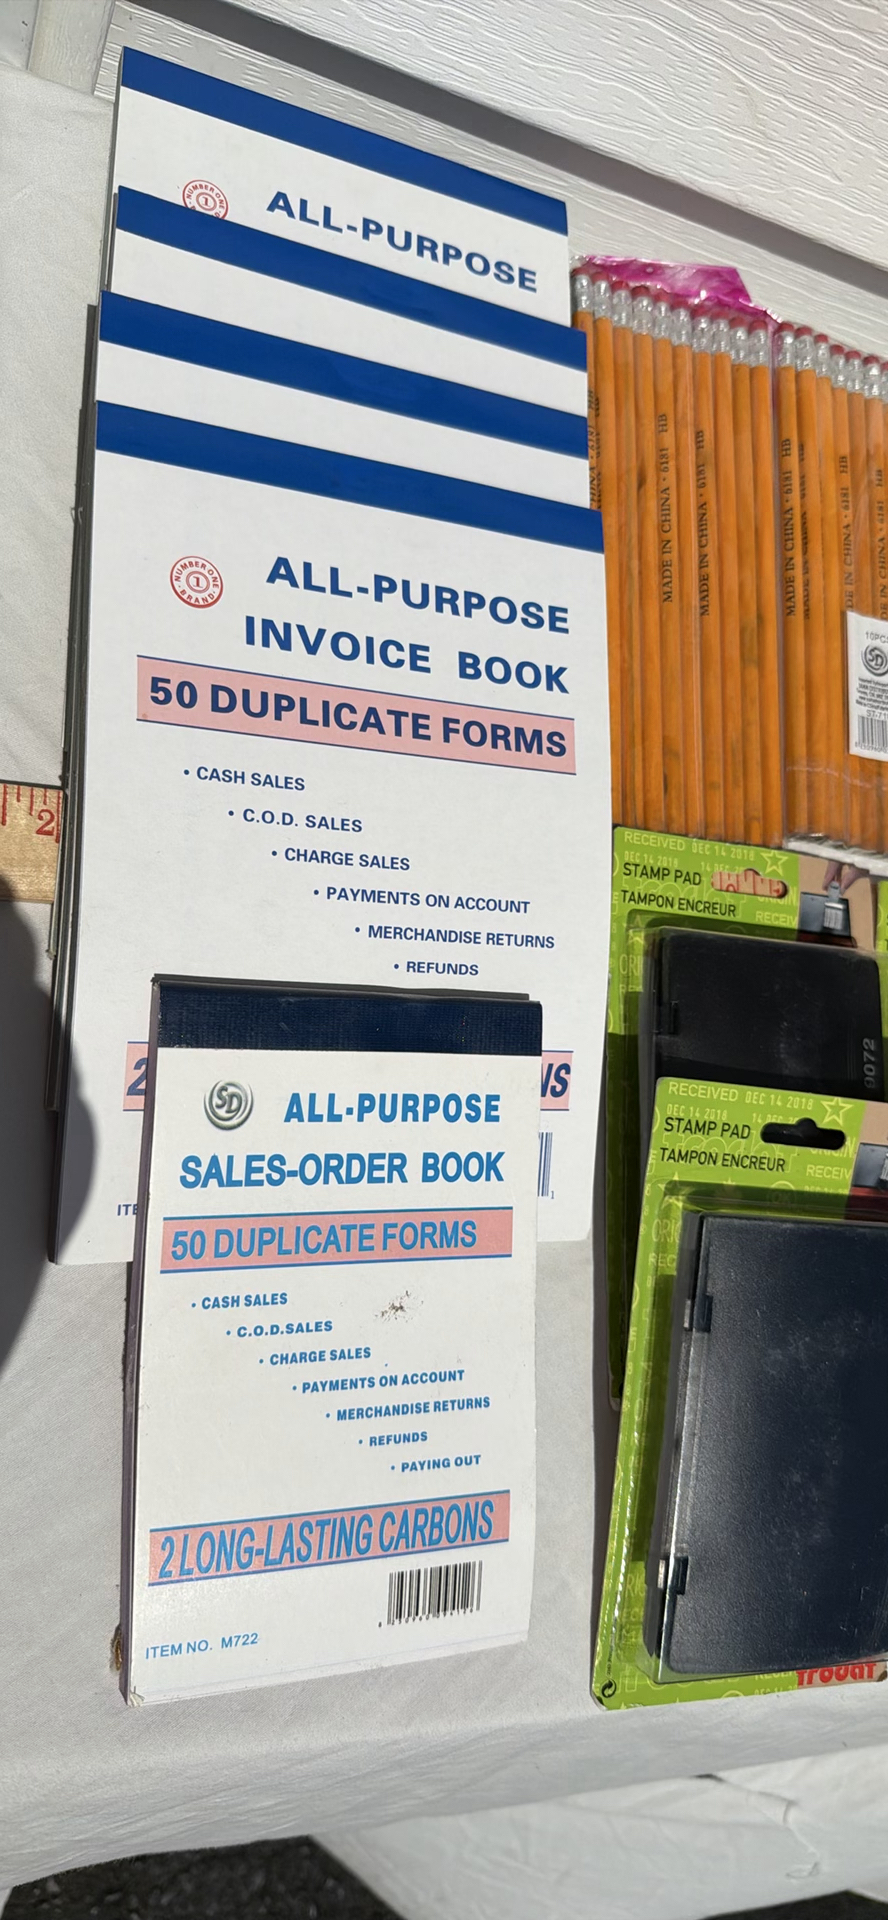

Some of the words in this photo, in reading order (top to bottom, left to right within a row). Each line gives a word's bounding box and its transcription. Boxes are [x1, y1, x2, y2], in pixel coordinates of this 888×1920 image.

[186, 183, 215, 200] NUMBER
[215, 192, 225, 210] ONE
[266, 191, 537, 293] ALL-PURPOSE
[658, 413, 668, 434] HB
[696, 430, 704, 449] HB
[782, 438, 791, 457] HB
[659, 447, 670, 473] 6181
[839, 455, 849, 474] HB
[697, 463, 706, 489] 6181
[783, 471, 793, 495] 6181
[875, 468, 883, 488] HB
[661, 486, 672, 533] CHINA
[840, 486, 850, 513] 6181
[698, 502, 708, 549] CHINA
[784, 507, 794, 551] CHINA
[662, 539, 672, 555] IN
[842, 523, 852, 567] CHINA
[878, 536, 887, 580] CHINA
[174, 560, 207, 582] NUMBER
[207, 569, 220, 589] ONE
[699, 553, 709, 570] IN
[785, 556, 795, 571] IN
[192, 575, 204, 589] 1
[662, 560, 673, 604] MADE
[844, 572, 853, 587] IN
[180, 589, 215, 604] BRAND
[266, 556, 570, 635] ALL-PURPOSE
[700, 573, 710, 617] MADE
[786, 575, 796, 617] MADE
[245, 615, 432, 674] INVOICE
[458, 651, 570, 695] BOOK
[149, 675, 198, 709] 50
[210, 684, 432, 741] DUPLICATE
[442, 717, 567, 758] FORMS
[196, 765, 245, 786] CASH
[250, 772, 306, 791] SALES
[36, 808, 55, 836] 2
[242, 807, 299, 828] C.O.D.
[305, 814, 363, 834] SALES
[624, 831, 686, 851] RECEIVED
[691, 842, 710, 855] DEC
[714, 845, 727, 857] 14
[284, 847, 354, 867] CHARGE
[358, 854, 411, 871] SALES
[624, 850, 640, 862] DEC
[643, 853, 654, 865] 14
[623, 862, 671, 882] STAMP
[674, 869, 701, 886] PAD
[326, 886, 421, 907] PAYMENTS
[425, 893, 450, 909] ON
[453, 896, 531, 915] ACCOUNT
[621, 889, 674, 910] TAMPON
[678, 896, 736, 917] ENCREUR
[367, 924, 482, 945] MERCHANDISE
[486, 932, 555, 950] RETURNS
[406, 960, 480, 977] REFUNDS
[863, 1037, 876, 1089] 9072
[284, 1092, 501, 1124] ALL-PURPOSE
[668, 1081, 739, 1101] RECEIVED
[745, 1091, 765, 1105] DEC
[769, 1094, 783, 1106] 14
[786, 1096, 814, 1110] 2018
[667, 1103, 683, 1115] DEC
[689, 1106, 700, 1117] 14
[704, 1108, 728, 1119] 2018
[751, 1112, 762, 1124] 14
[664, 1116, 717, 1136] STAMP
[720, 1122, 751, 1140] PAD
[179, 1152, 409, 1189] SALES-ORDER
[421, 1151, 505, 1184] BOOK
[660, 1147, 718, 1166] TAMPON
[721, 1153, 785, 1172] ENCREUR
[171, 1229, 206, 1261] 50
[213, 1222, 375, 1259] DUPLICATE
[382, 1219, 478, 1251] FORMS
[201, 1294, 241, 1310] CASH
[243, 1292, 288, 1307] SALES
[236, 1320, 334, 1338] C.O.D.SALES
[269, 1350, 326, 1366] CHARGE
[329, 1346, 372, 1362] SALES
[301, 1375, 376, 1394] PAYMENTS
[378, 1375, 399, 1388] ON
[401, 1369, 466, 1386] ACCOUNT
[336, 1401, 431, 1421] MERCHANDISE
[433, 1396, 491, 1413] RETURNS
[369, 1431, 429, 1447] REFUNDS
[401, 1457, 452, 1473] PAYING
[454, 1454, 482, 1468] OUT
[158, 1535, 175, 1579] 2
[179, 1512, 374, 1577] LONG-LASTING
[378, 1499, 495, 1551] CARBONS
[145, 1644, 183, 1660] ITEM
[186, 1638, 213, 1653] NO.
[220, 1632, 259, 1650] M722
